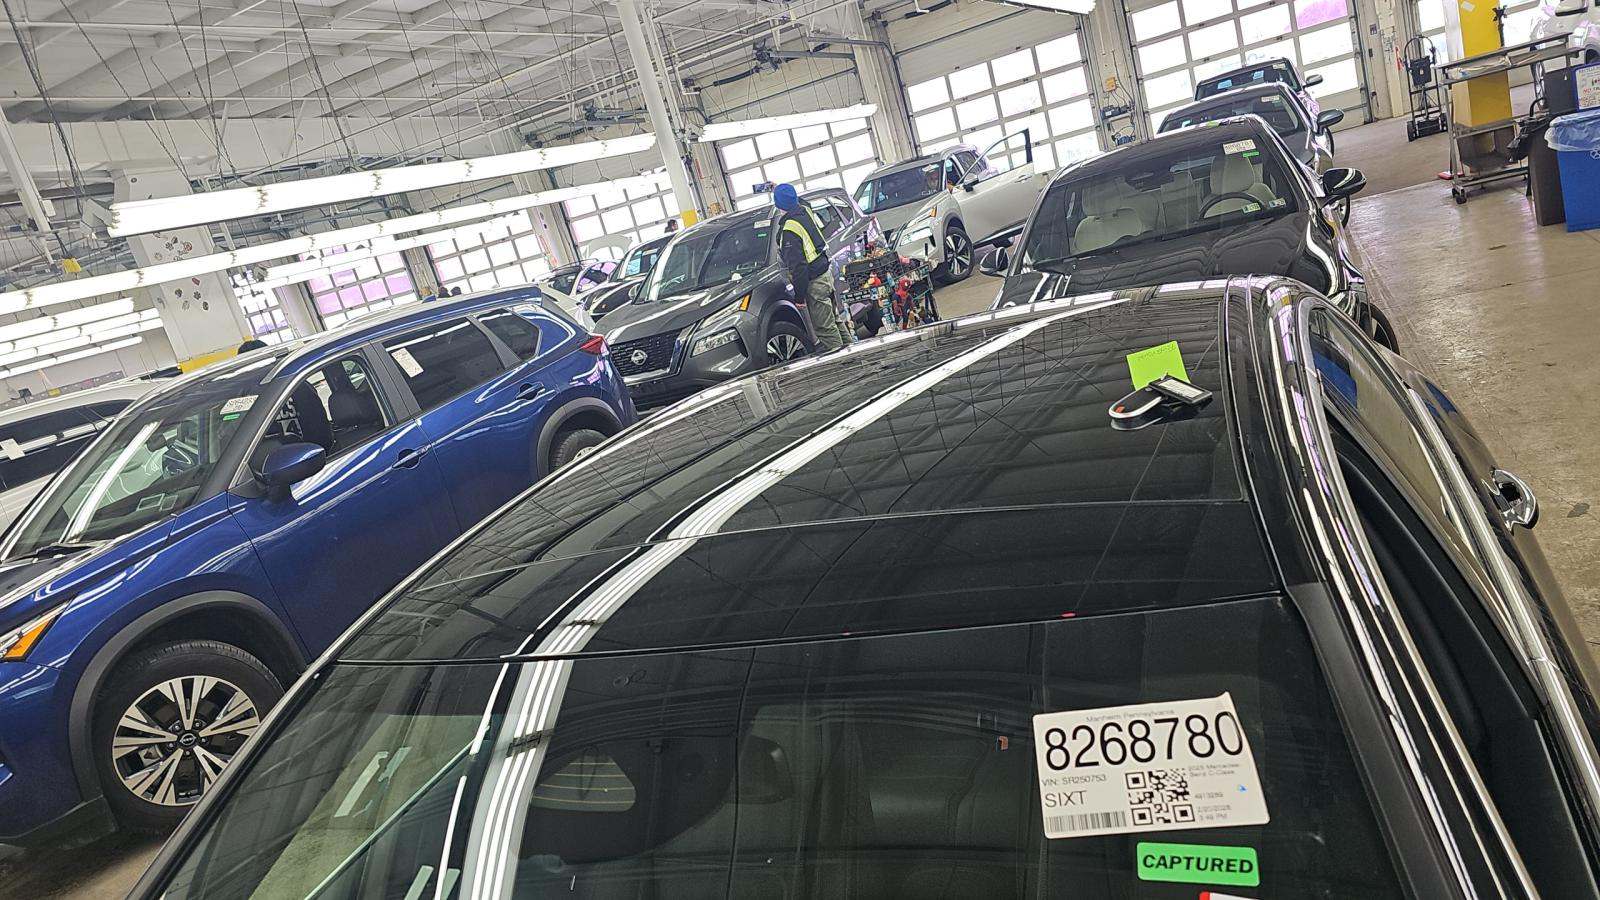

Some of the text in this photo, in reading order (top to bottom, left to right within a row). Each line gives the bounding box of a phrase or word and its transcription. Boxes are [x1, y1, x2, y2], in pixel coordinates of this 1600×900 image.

[1086, 709, 1174, 722] Manheim Pennsylvania
[1044, 711, 1243, 771] 8268780
[1041, 778, 1057, 787] VIN:
[1045, 790, 1087, 808] SIXT
[1142, 854, 1254, 874] CAPTURED
